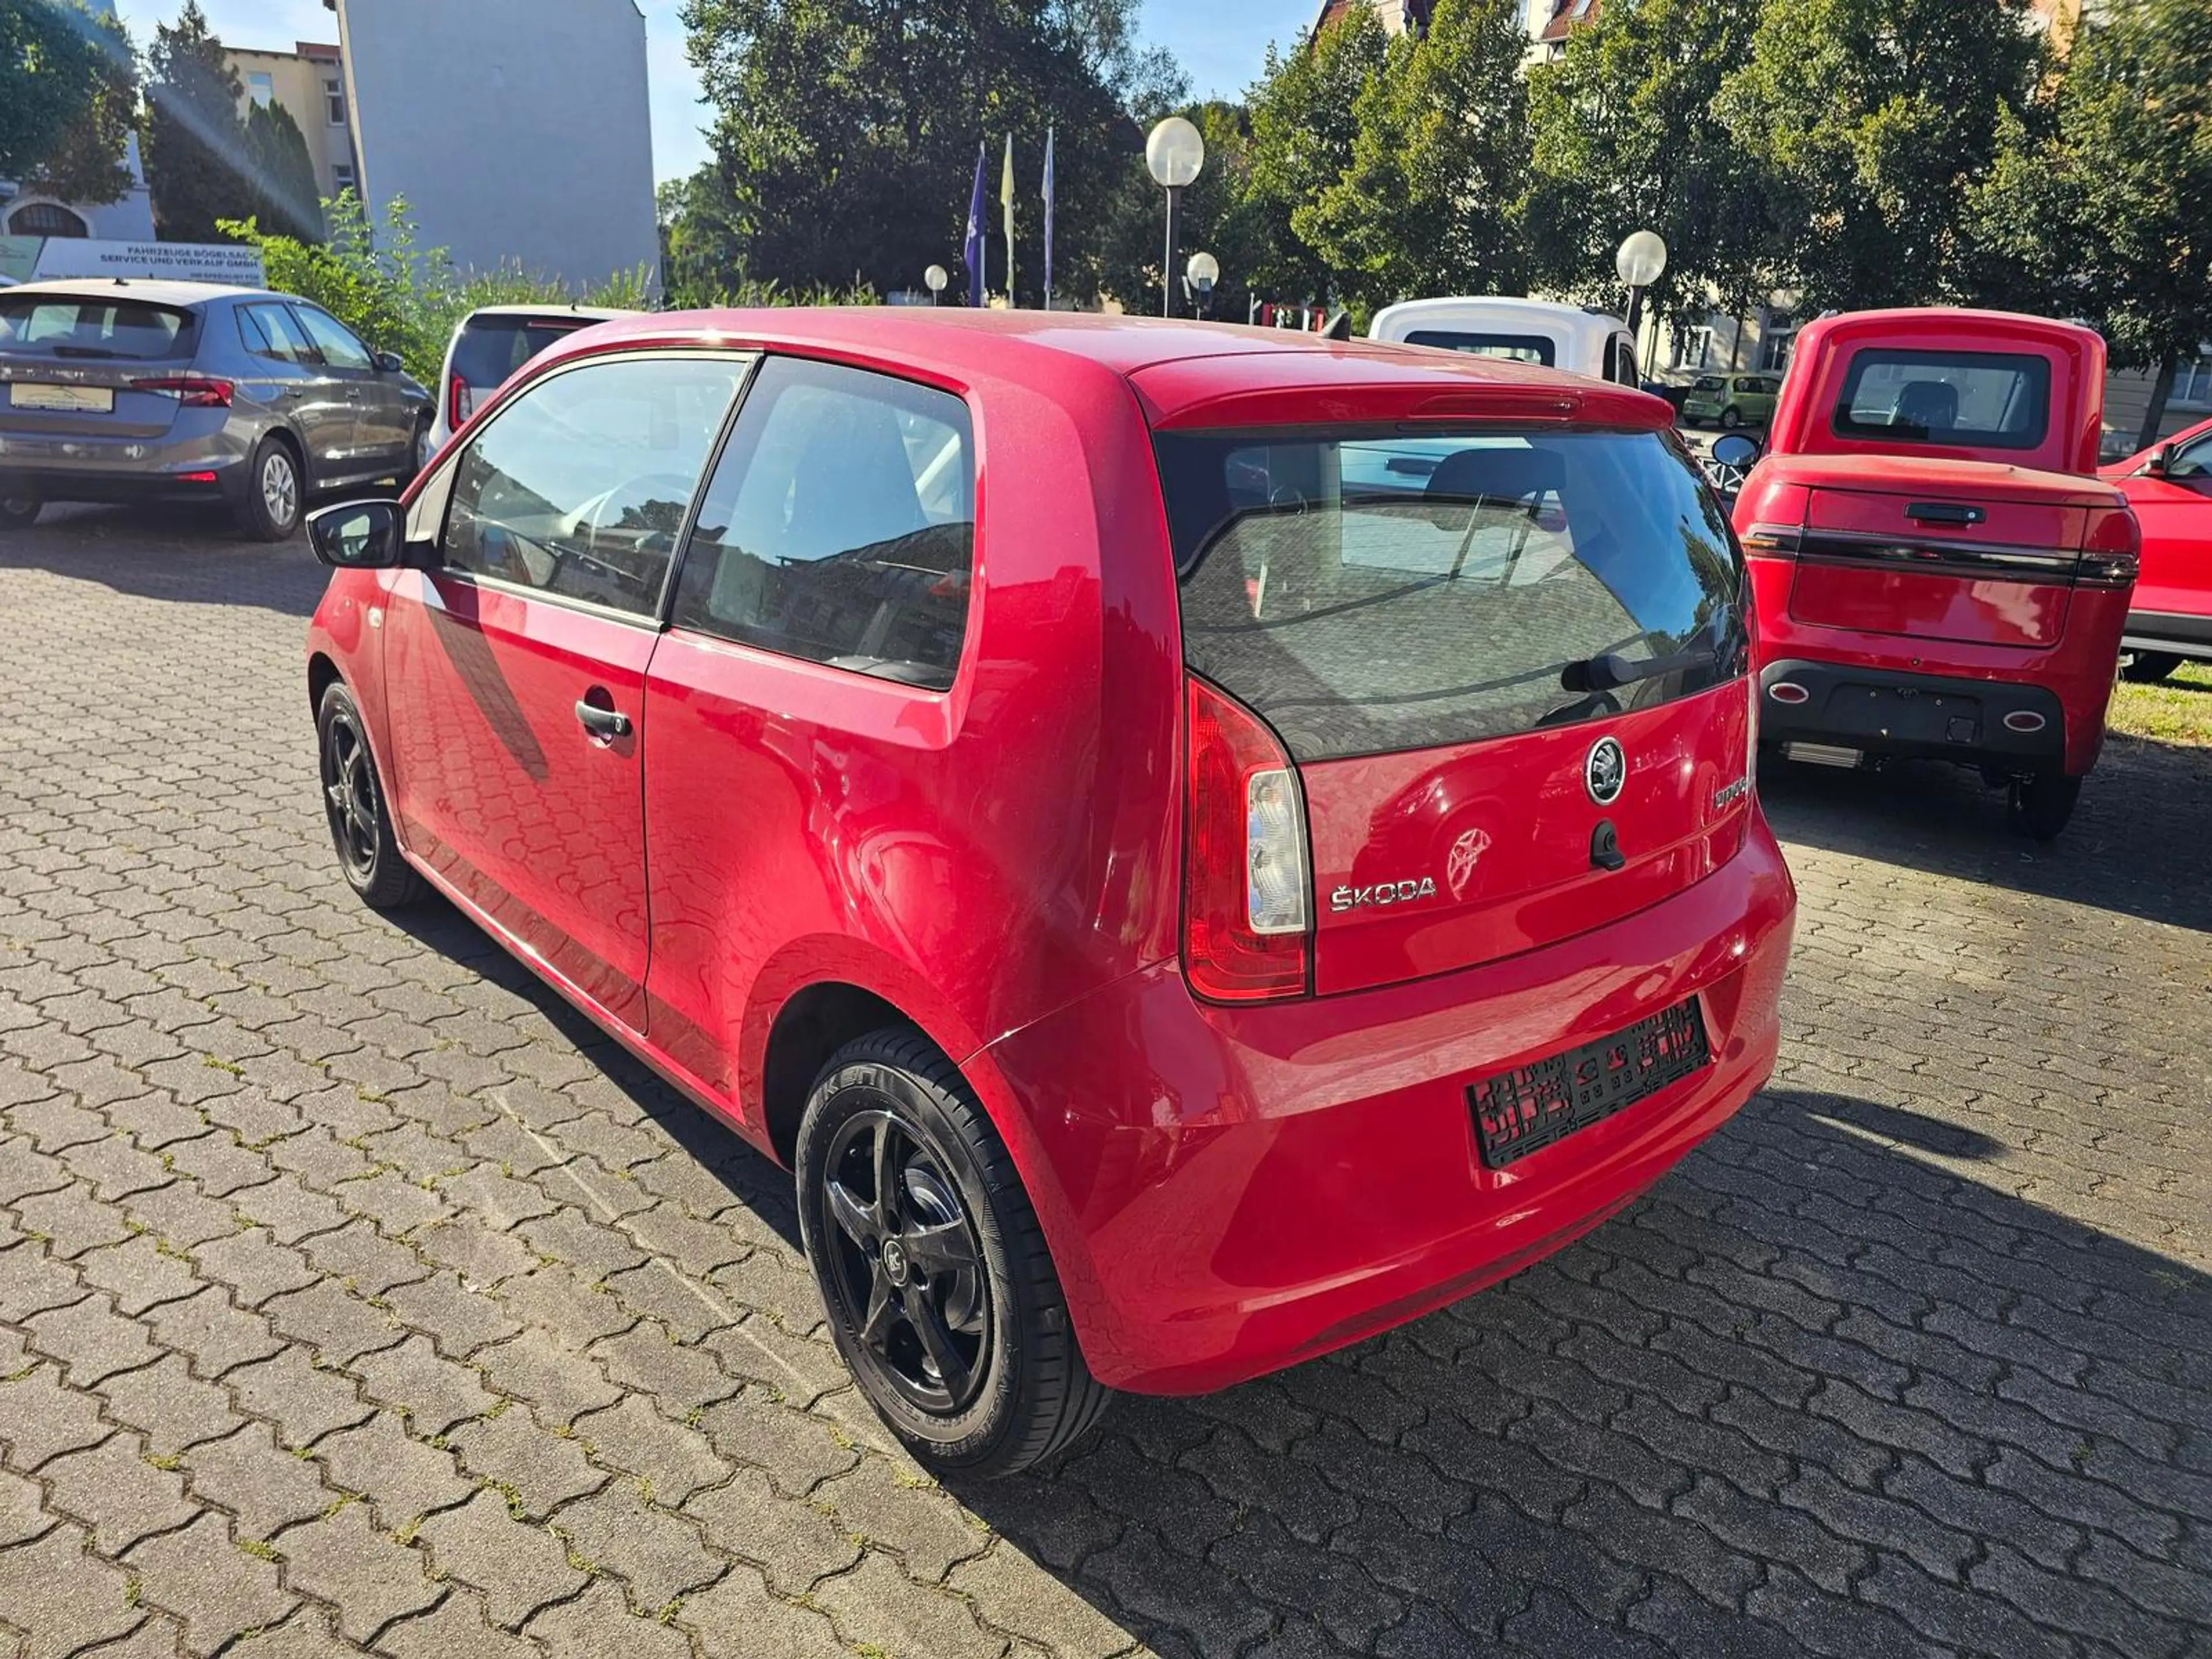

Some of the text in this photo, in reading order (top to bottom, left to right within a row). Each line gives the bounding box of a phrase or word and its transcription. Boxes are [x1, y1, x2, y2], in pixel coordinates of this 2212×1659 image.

[100, 254, 149, 264] SERVICE
[150, 256, 173, 265] UND
[175, 257, 224, 267] VERKAUF
[1330, 876, 1437, 912] ŠKODA
